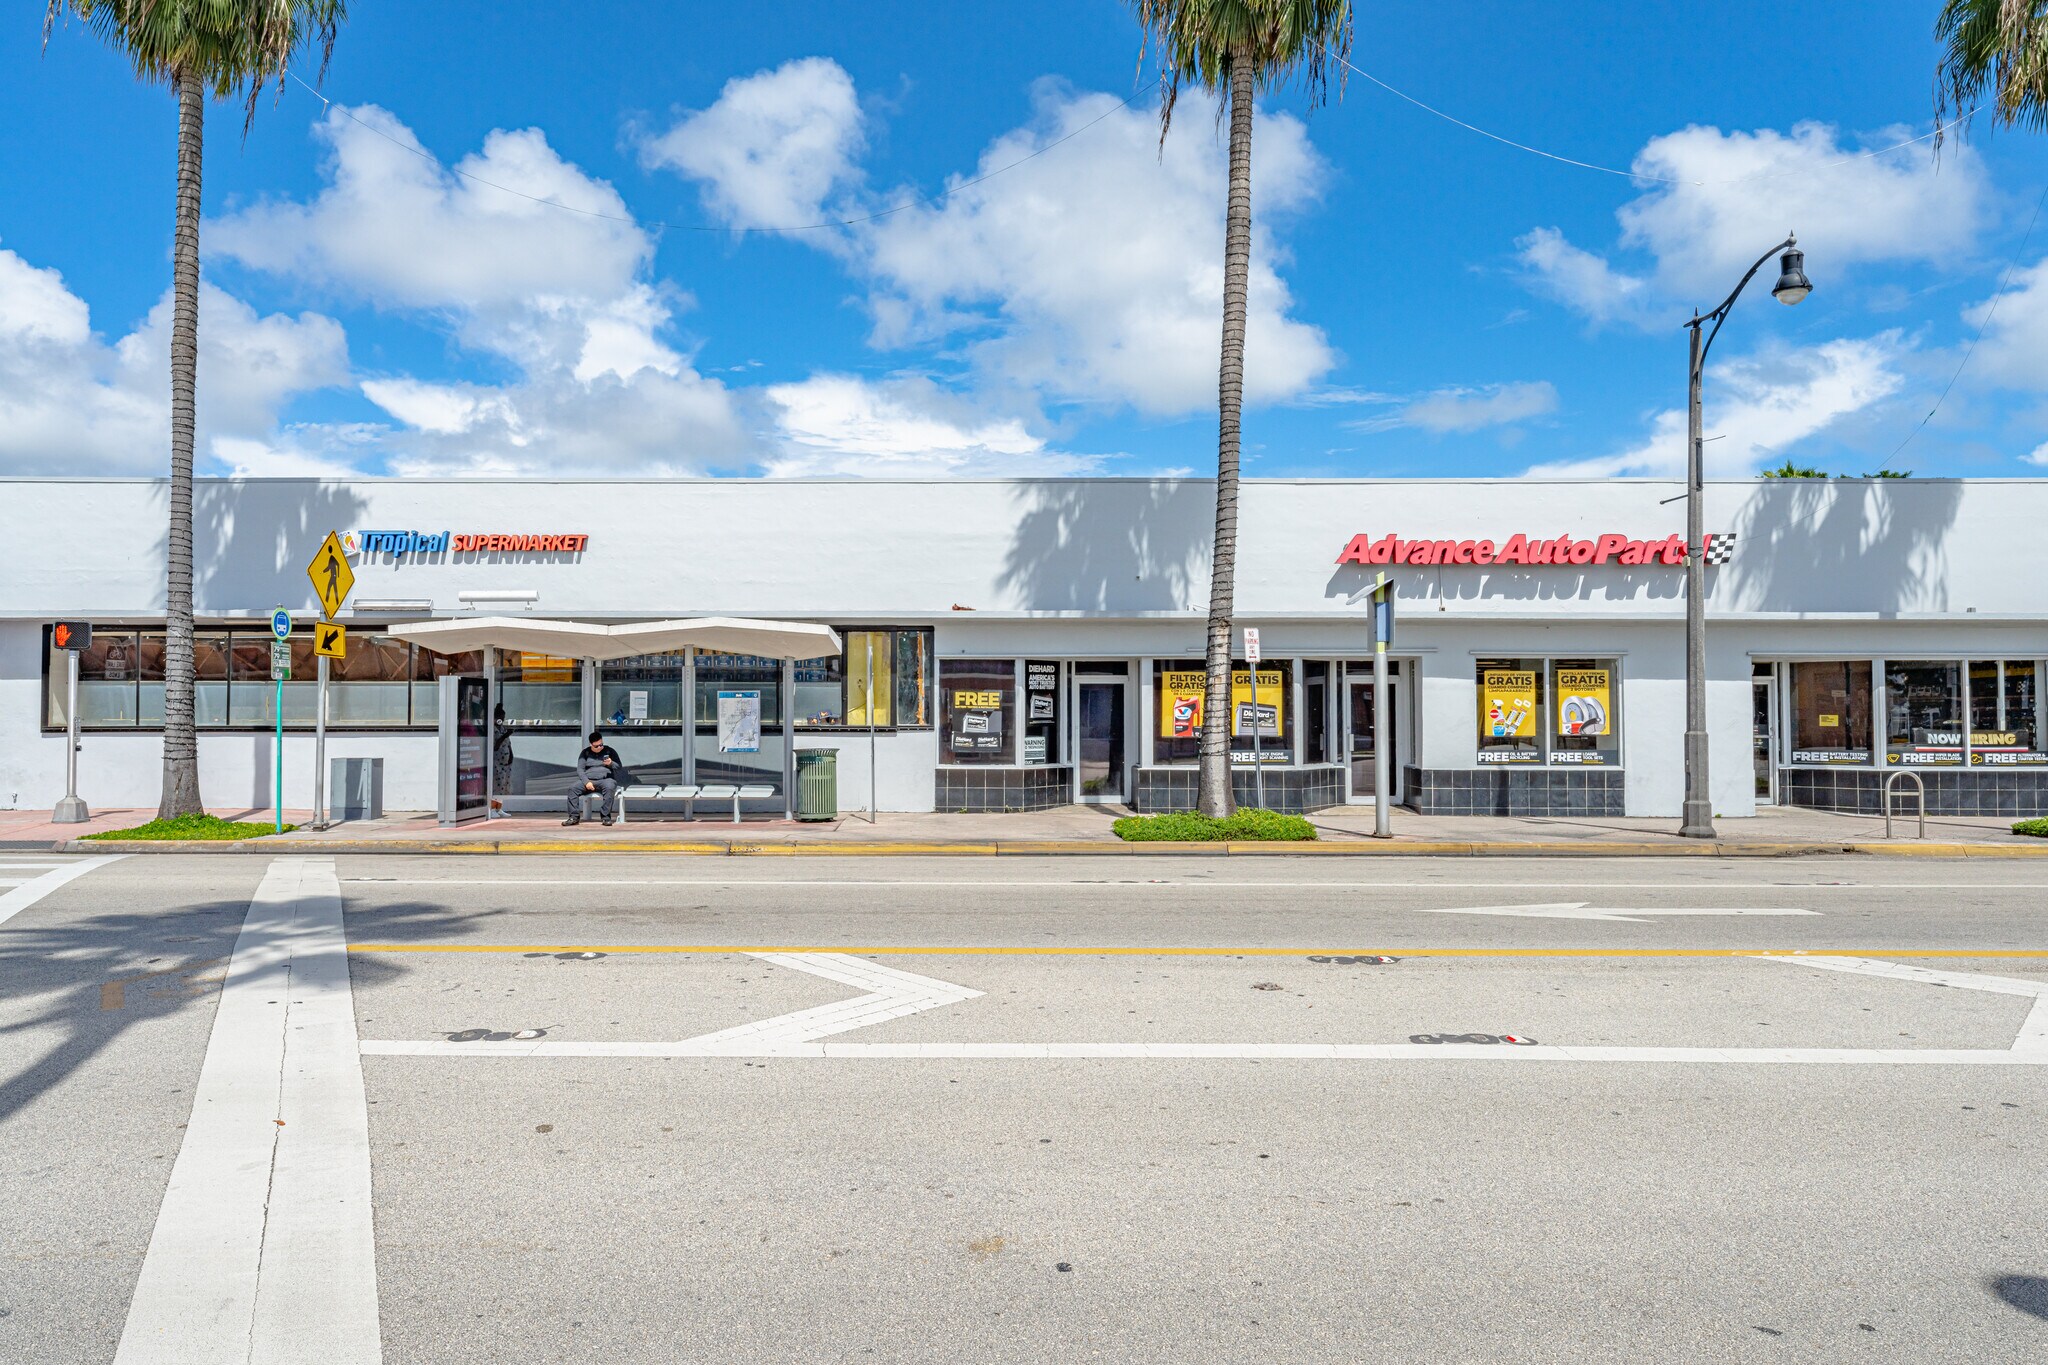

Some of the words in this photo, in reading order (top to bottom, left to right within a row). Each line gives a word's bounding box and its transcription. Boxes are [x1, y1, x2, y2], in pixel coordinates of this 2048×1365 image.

[358, 530, 450, 558] Tropical
[452, 534, 588, 551] SUPERMARKET
[1335, 533, 1495, 565] Advance
[1028, 664, 1055, 673] DIEHARD
[1235, 676, 1279, 684] GRATIS
[1488, 677, 1532, 685] GRATIS
[1561, 676, 1605, 684] GRATIS
[955, 692, 1000, 705] FREE
[1244, 710, 1270, 718] Dieard
[1928, 734, 1962, 745] NOW
[1230, 752, 1256, 762] REE
[1478, 752, 1509, 762] FREE
[1550, 752, 1582, 762] FREE
[1792, 752, 1829, 761] FREE
[1902, 753, 1935, 763] FREE
[1985, 754, 2017, 763] FREE
